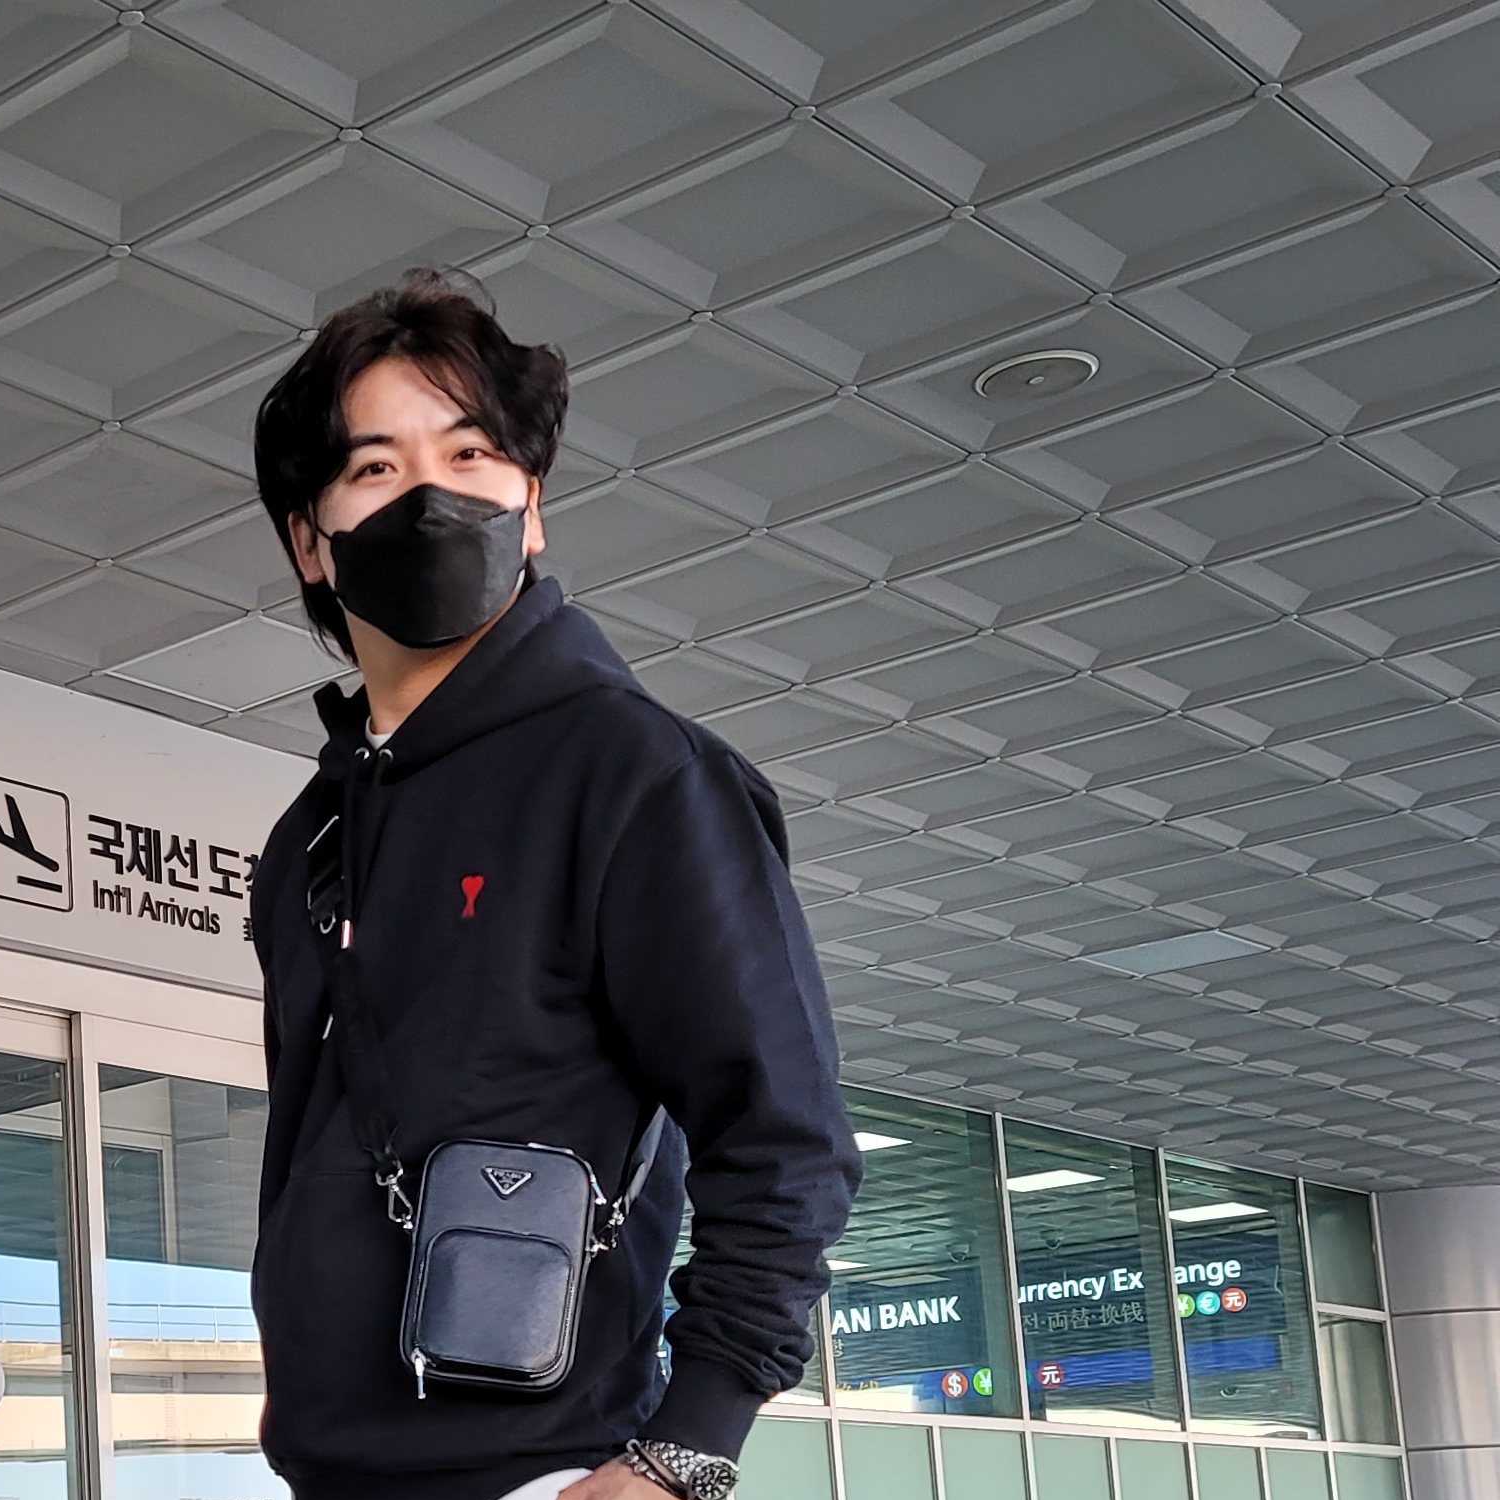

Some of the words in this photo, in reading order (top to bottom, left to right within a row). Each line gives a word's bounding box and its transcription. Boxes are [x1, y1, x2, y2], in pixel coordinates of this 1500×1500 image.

[88, 814, 199, 893] 국제선
[138, 891, 221, 935] Arrivals
[878, 1296, 962, 1331] BANK
